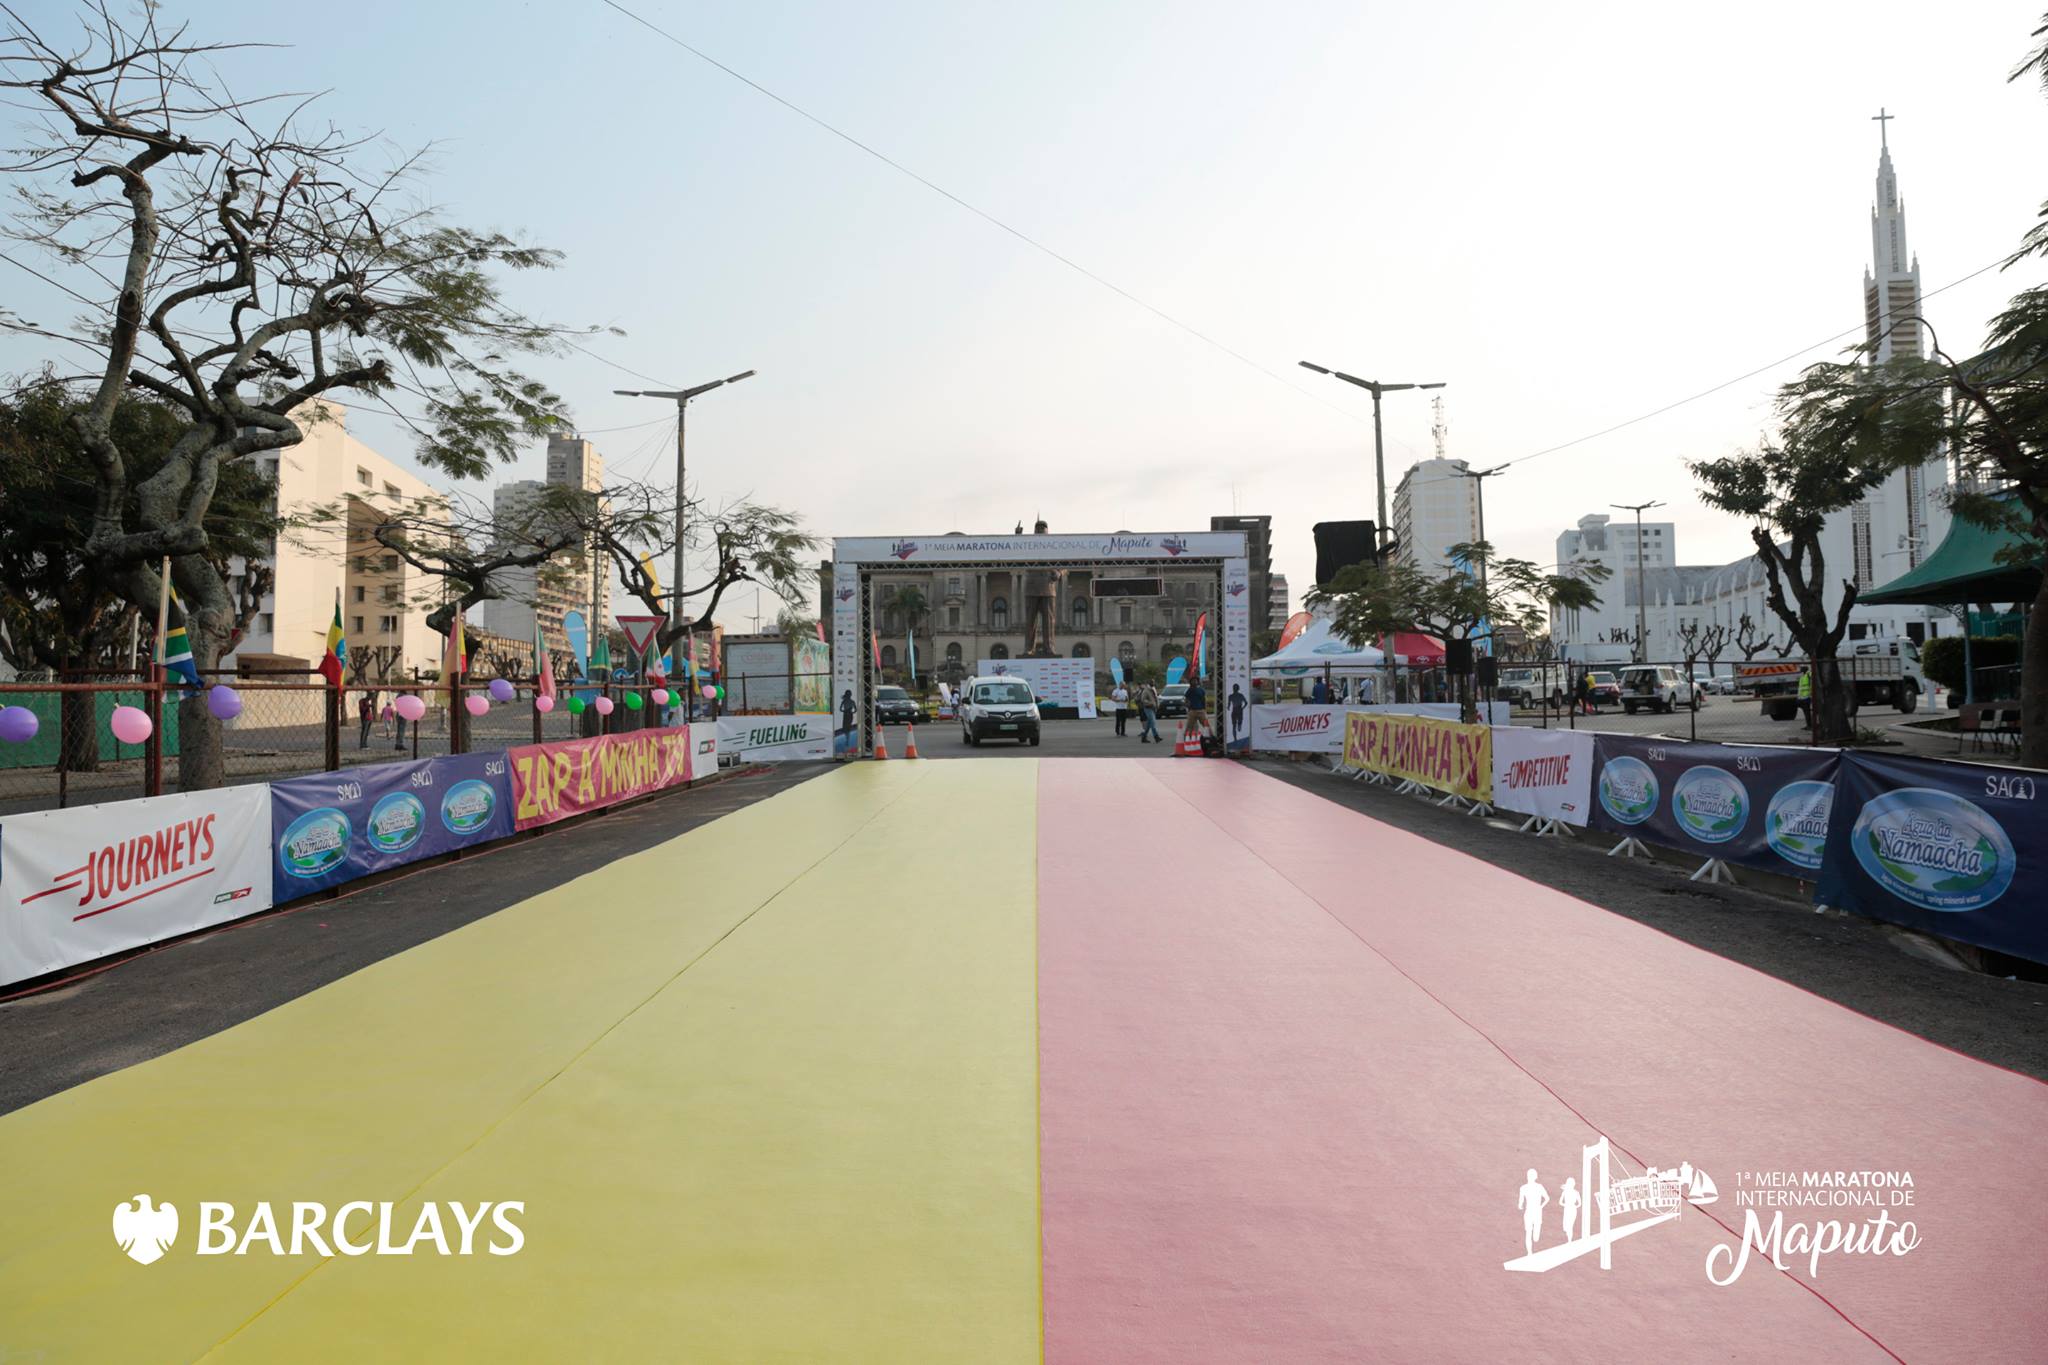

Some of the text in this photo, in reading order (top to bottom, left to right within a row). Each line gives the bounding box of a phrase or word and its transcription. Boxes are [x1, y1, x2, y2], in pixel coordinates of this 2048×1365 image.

[936, 543, 955, 551] MEIA
[956, 541, 1011, 551] MARATONA
[1013, 540, 1086, 551] INTERNACIONAL
[1088, 540, 1101, 550] DE
[1101, 536, 1153, 556] Maputo
[749, 723, 807, 746] FUELLING
[1278, 712, 1331, 734] JOURNEYS
[1349, 719, 1482, 790] ZAP A MINHA TV
[517, 753, 573, 820] ZAP
[578, 748, 596, 804] A
[600, 736, 661, 799] MINHA
[1508, 754, 1571, 789] COMPETITIVE
[1686, 795, 1736, 819] Namaacha
[1936, 818, 1952, 842] da
[79, 814, 216, 906] JOURNEYS
[1879, 826, 1984, 876] Namaacha
